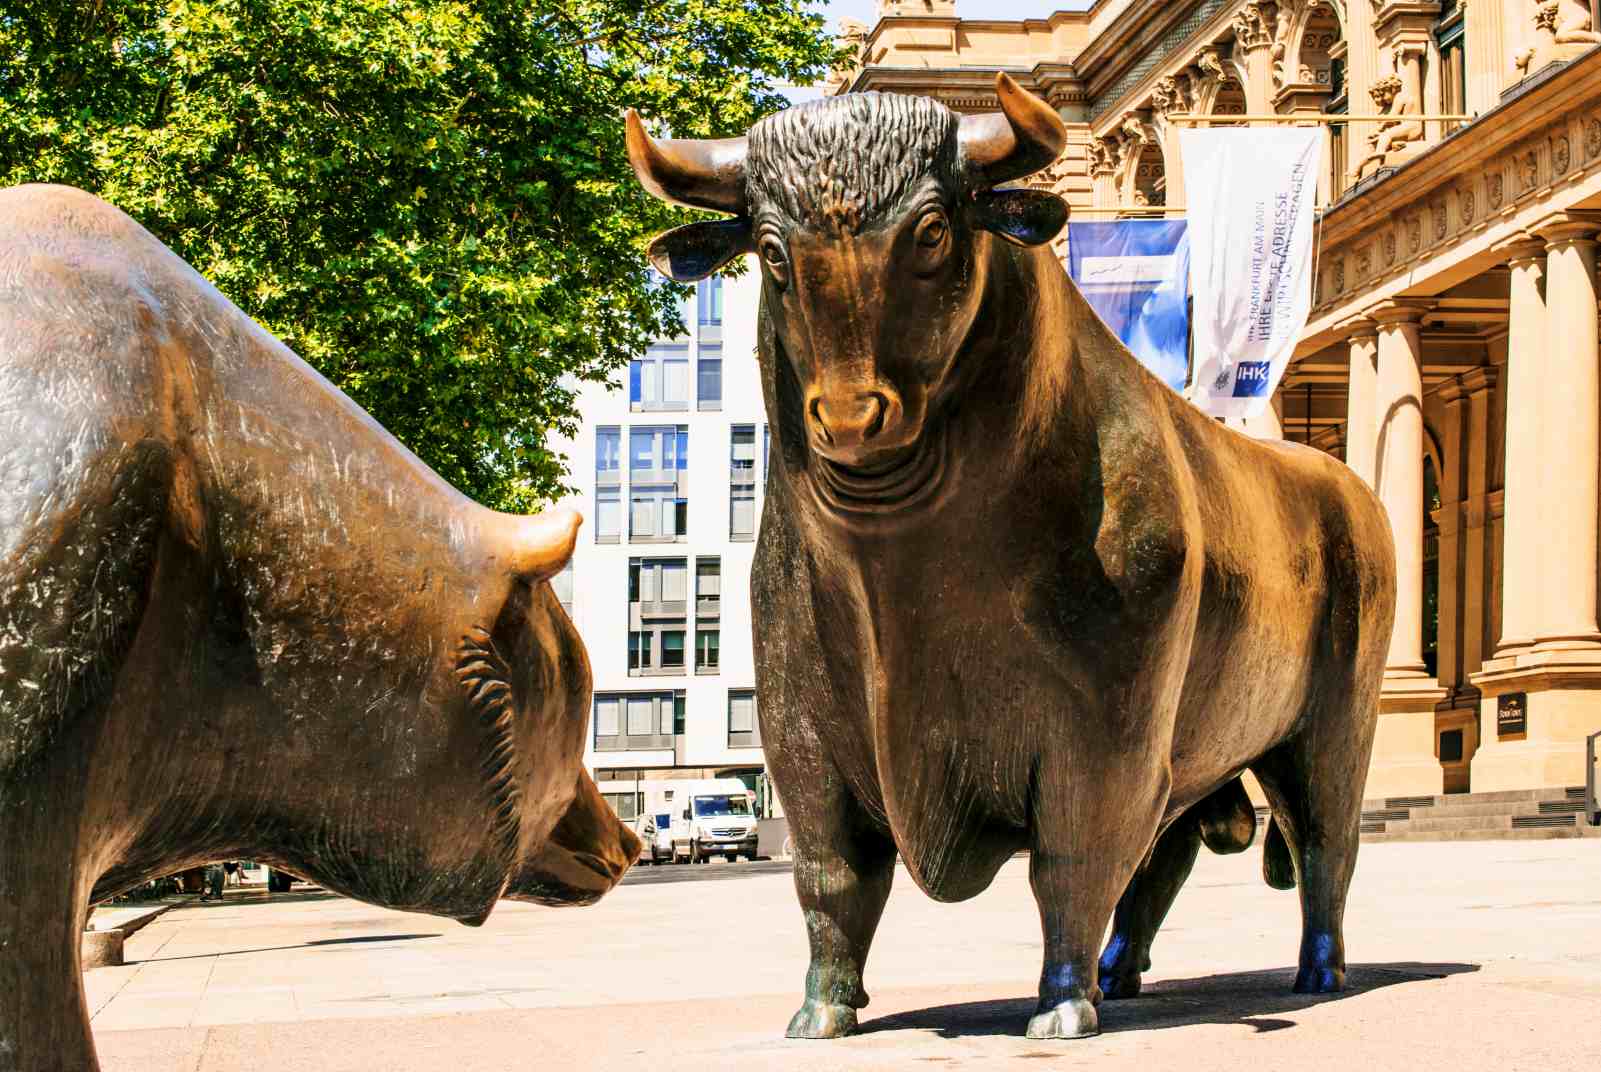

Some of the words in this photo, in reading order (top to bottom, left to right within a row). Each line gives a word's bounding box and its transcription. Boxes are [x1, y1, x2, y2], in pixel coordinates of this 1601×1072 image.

[1255, 202, 1265, 232] MAIN
[1253, 235, 1264, 254] AM
[1257, 307, 1272, 341] IHRE
[1271, 191, 1287, 256] ADRESSE
[1248, 257, 1262, 320] FRANKFURT
[1238, 366, 1266, 380] IHK
